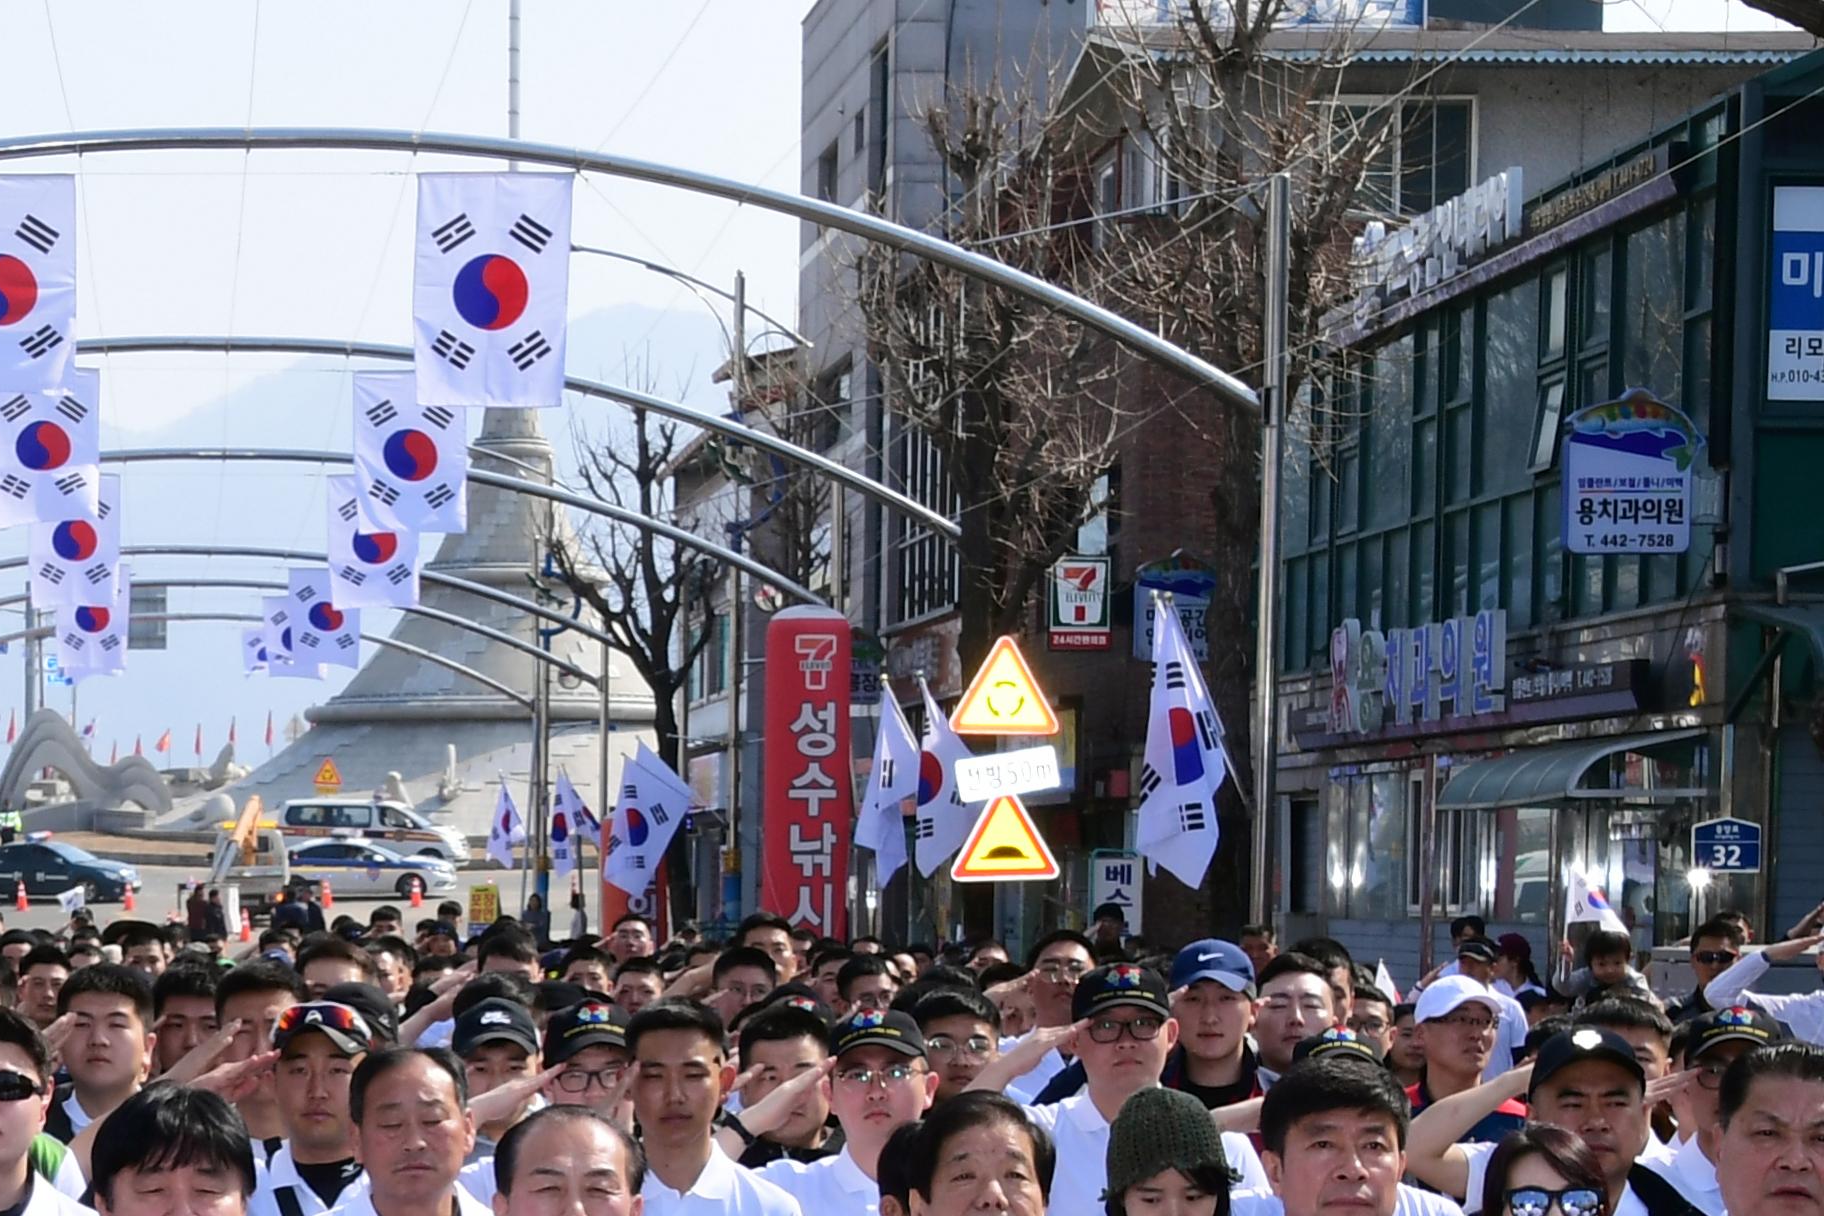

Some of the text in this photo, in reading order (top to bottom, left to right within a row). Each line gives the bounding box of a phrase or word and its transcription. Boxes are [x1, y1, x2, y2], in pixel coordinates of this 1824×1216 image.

[1575, 498, 1684, 525] 용치과의원
[1600, 534, 1674, 547] 442-7528
[787, 701, 838, 937] 성수낚시
[1712, 845, 1742, 867] 32
